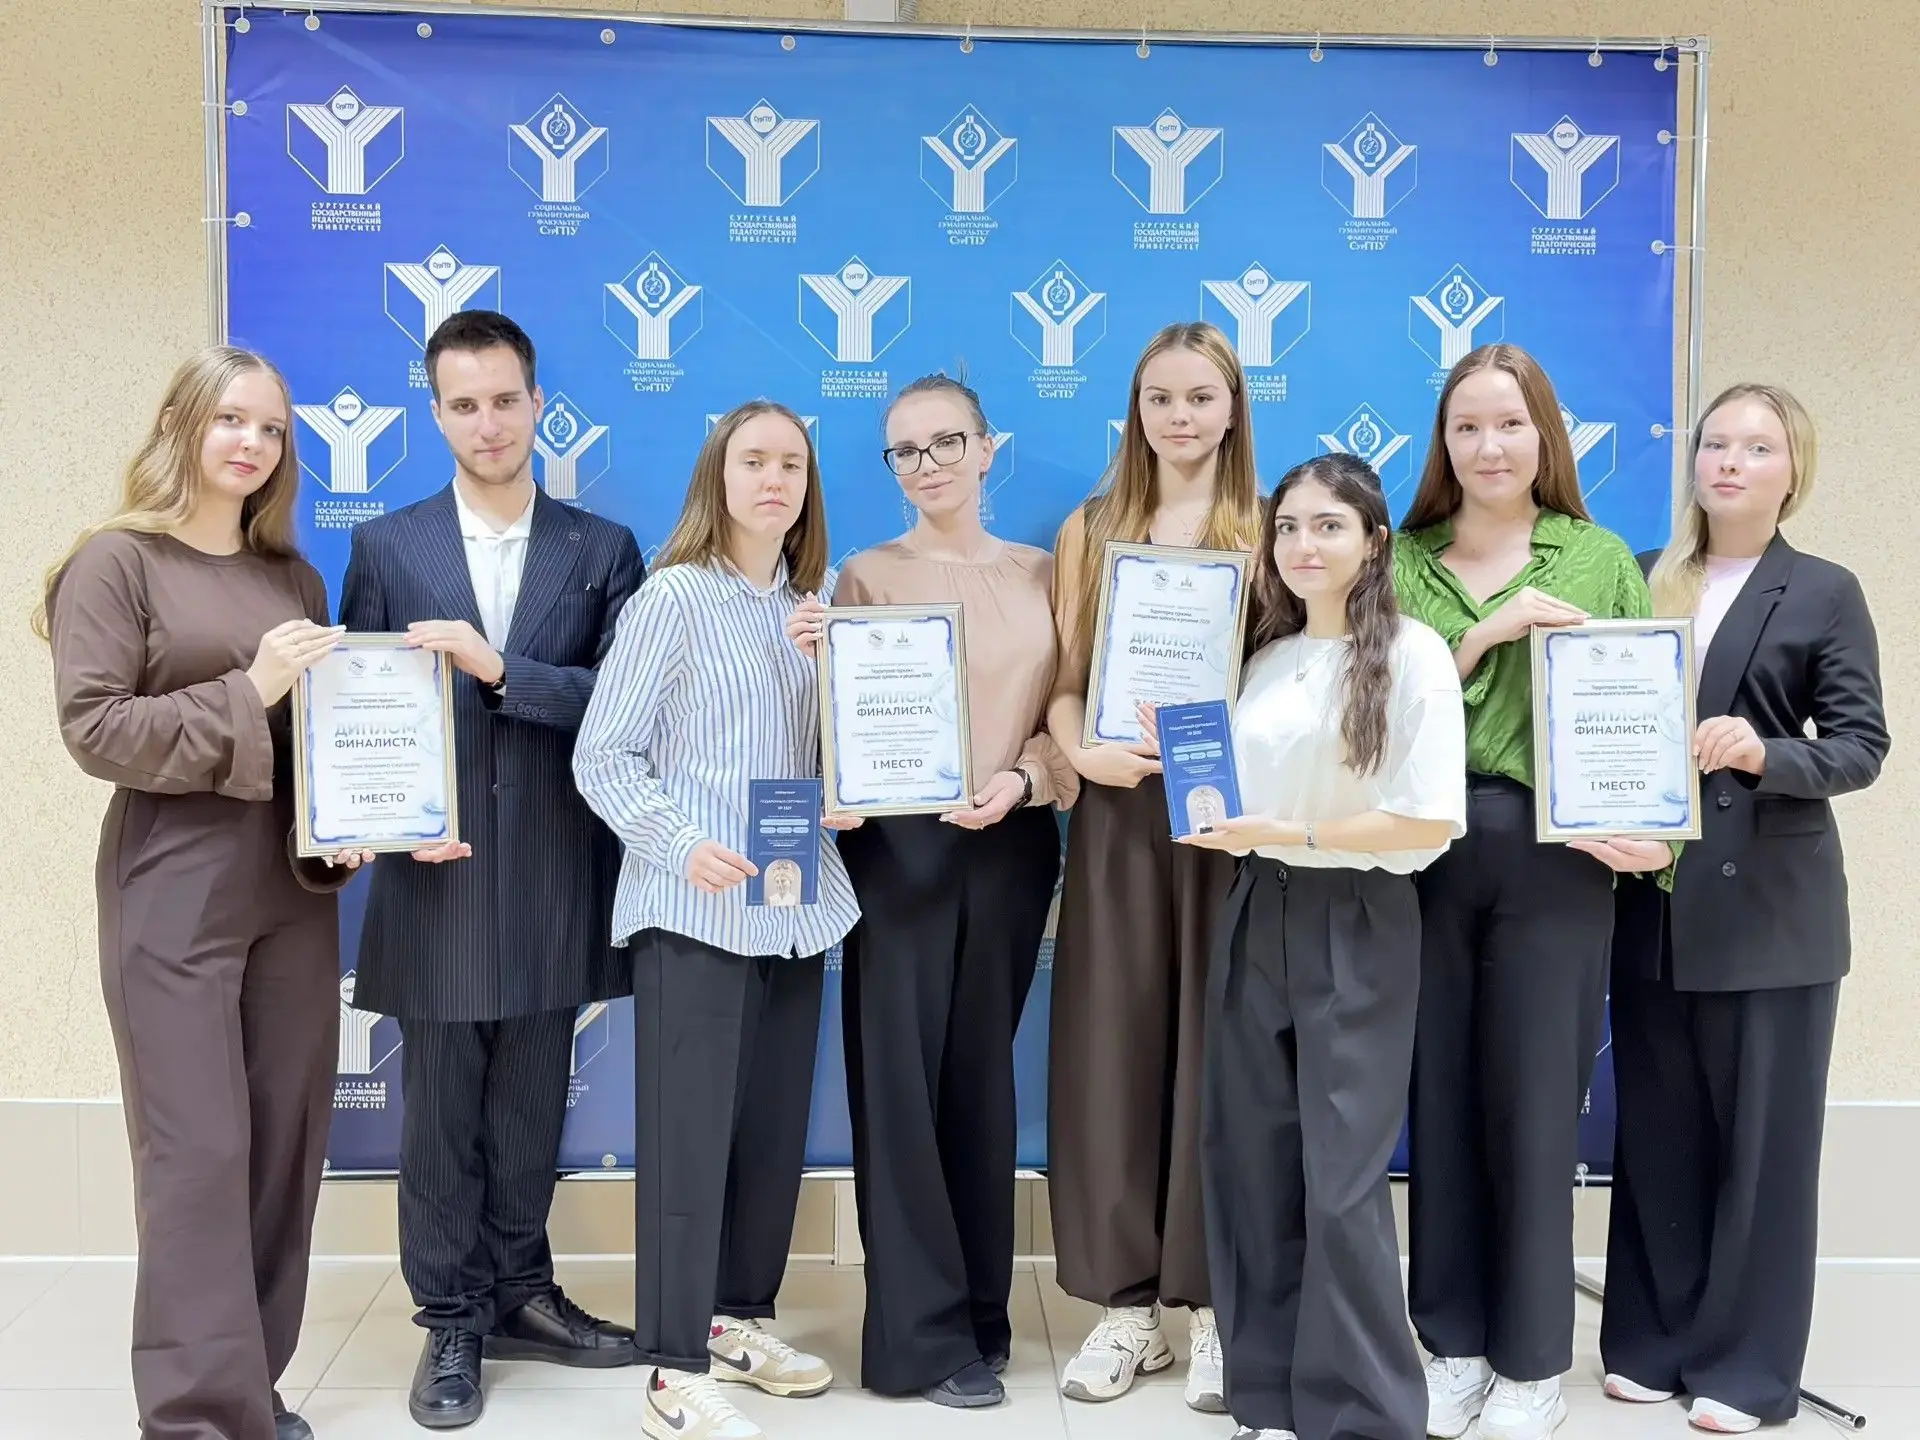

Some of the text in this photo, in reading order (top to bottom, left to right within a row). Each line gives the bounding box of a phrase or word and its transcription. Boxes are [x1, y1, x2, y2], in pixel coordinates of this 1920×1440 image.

[311, 202, 381, 210] СУРГУТСКИЙ
[311, 209, 381, 217] ГОСУДАРСТВЕННЫЙ
[729, 214, 797, 222] СУРГУТСКИЙ
[311, 216, 381, 224] ПЕДАГОГИЧЕСКИЙ
[729, 221, 797, 229] ГОСУДАРСТВЕННЫЙ
[311, 223, 381, 232] УНИВЕРСИТЕТ
[821, 369, 888, 377] СУРГУТСКИЙ
[1130, 631, 1206, 651] ДИПЛОМ
[1128, 645, 1204, 661] ФИНАЛИСТА
[856, 691, 932, 706] ДИПЛОМ
[856, 706, 933, 718] ФИНАЛИСТА
[1575, 709, 1658, 724] ДИПЛОМ
[334, 722, 416, 738] ДИПЛОМ
[1574, 725, 1658, 735] ФИНАЛИСТА
[334, 737, 417, 748] ФИНАЛИСТА
[880, 759, 923, 769] МЕСТО
[1599, 780, 1646, 791] МЕСТО
[359, 792, 406, 803] МЕСТО
